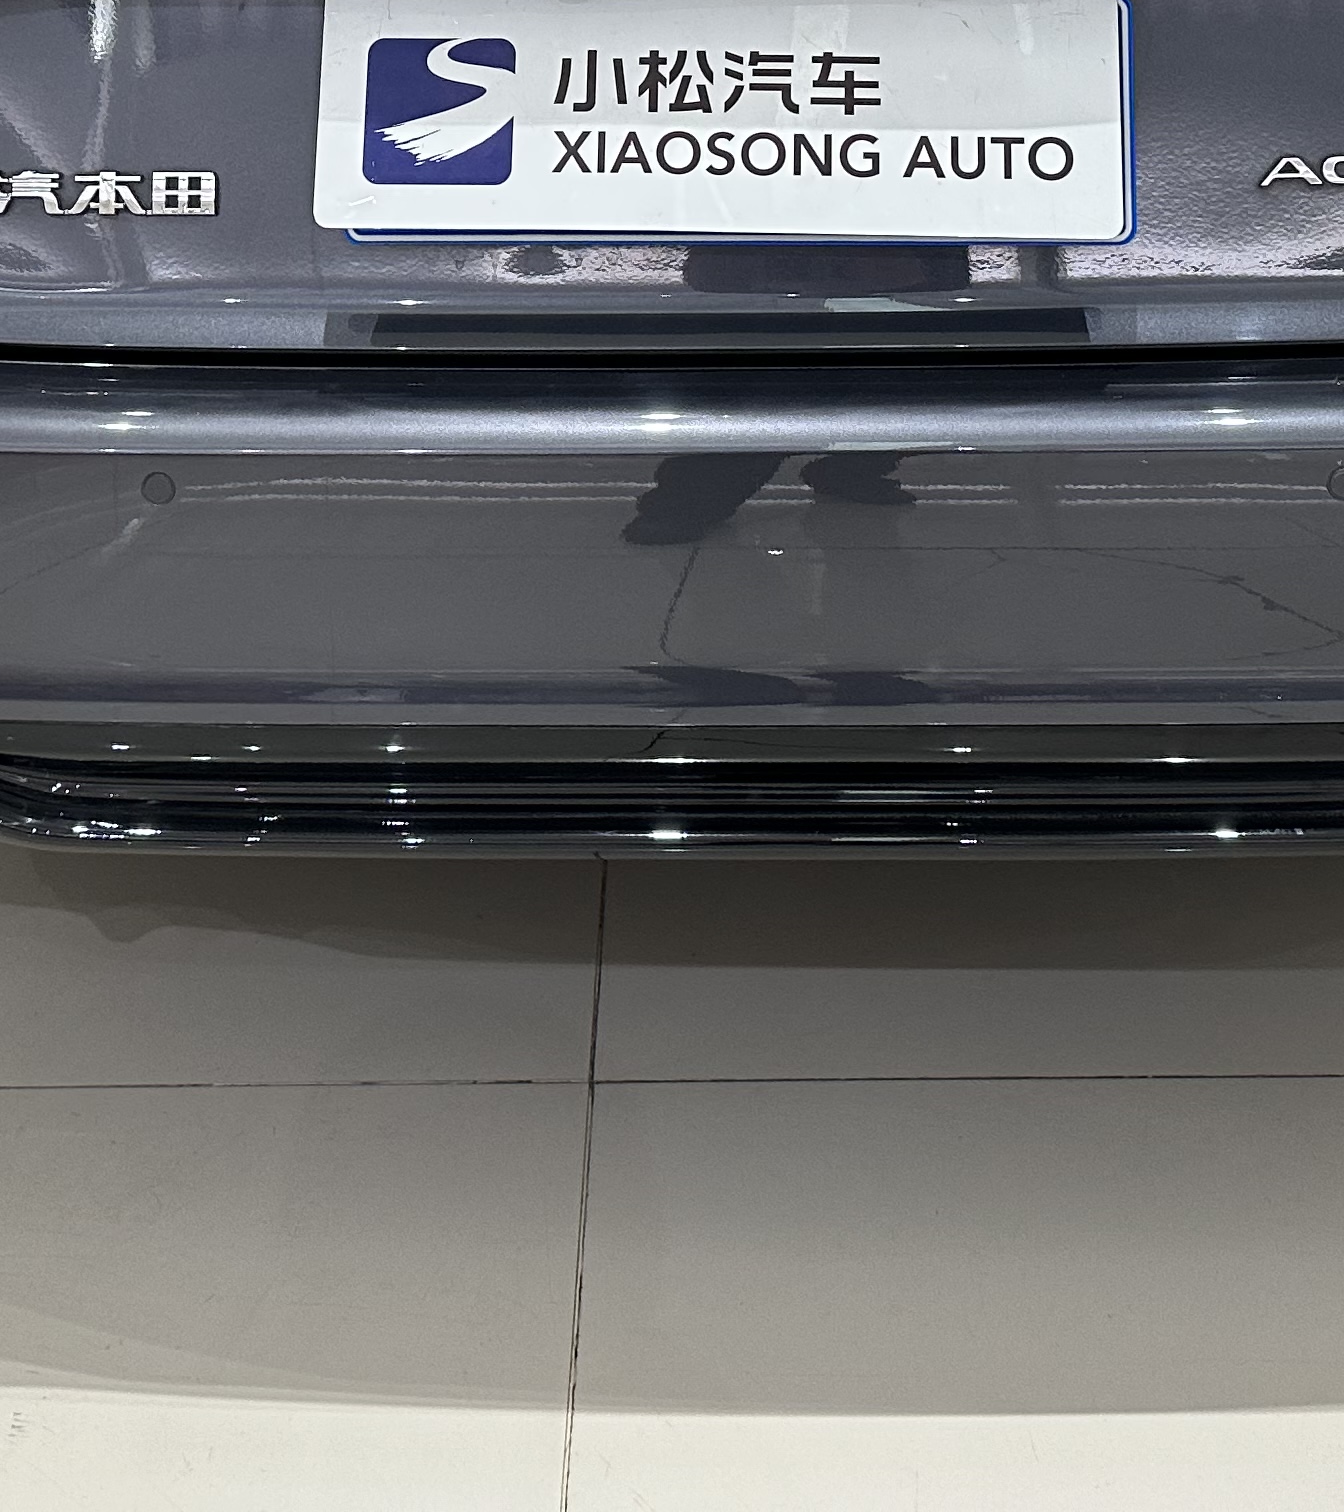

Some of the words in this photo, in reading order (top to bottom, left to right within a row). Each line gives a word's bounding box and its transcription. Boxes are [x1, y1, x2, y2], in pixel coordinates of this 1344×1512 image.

[553, 49, 882, 116] 小松汽车
[553, 130, 881, 177] XIAOSONG
[903, 135, 1075, 182] AUTO
